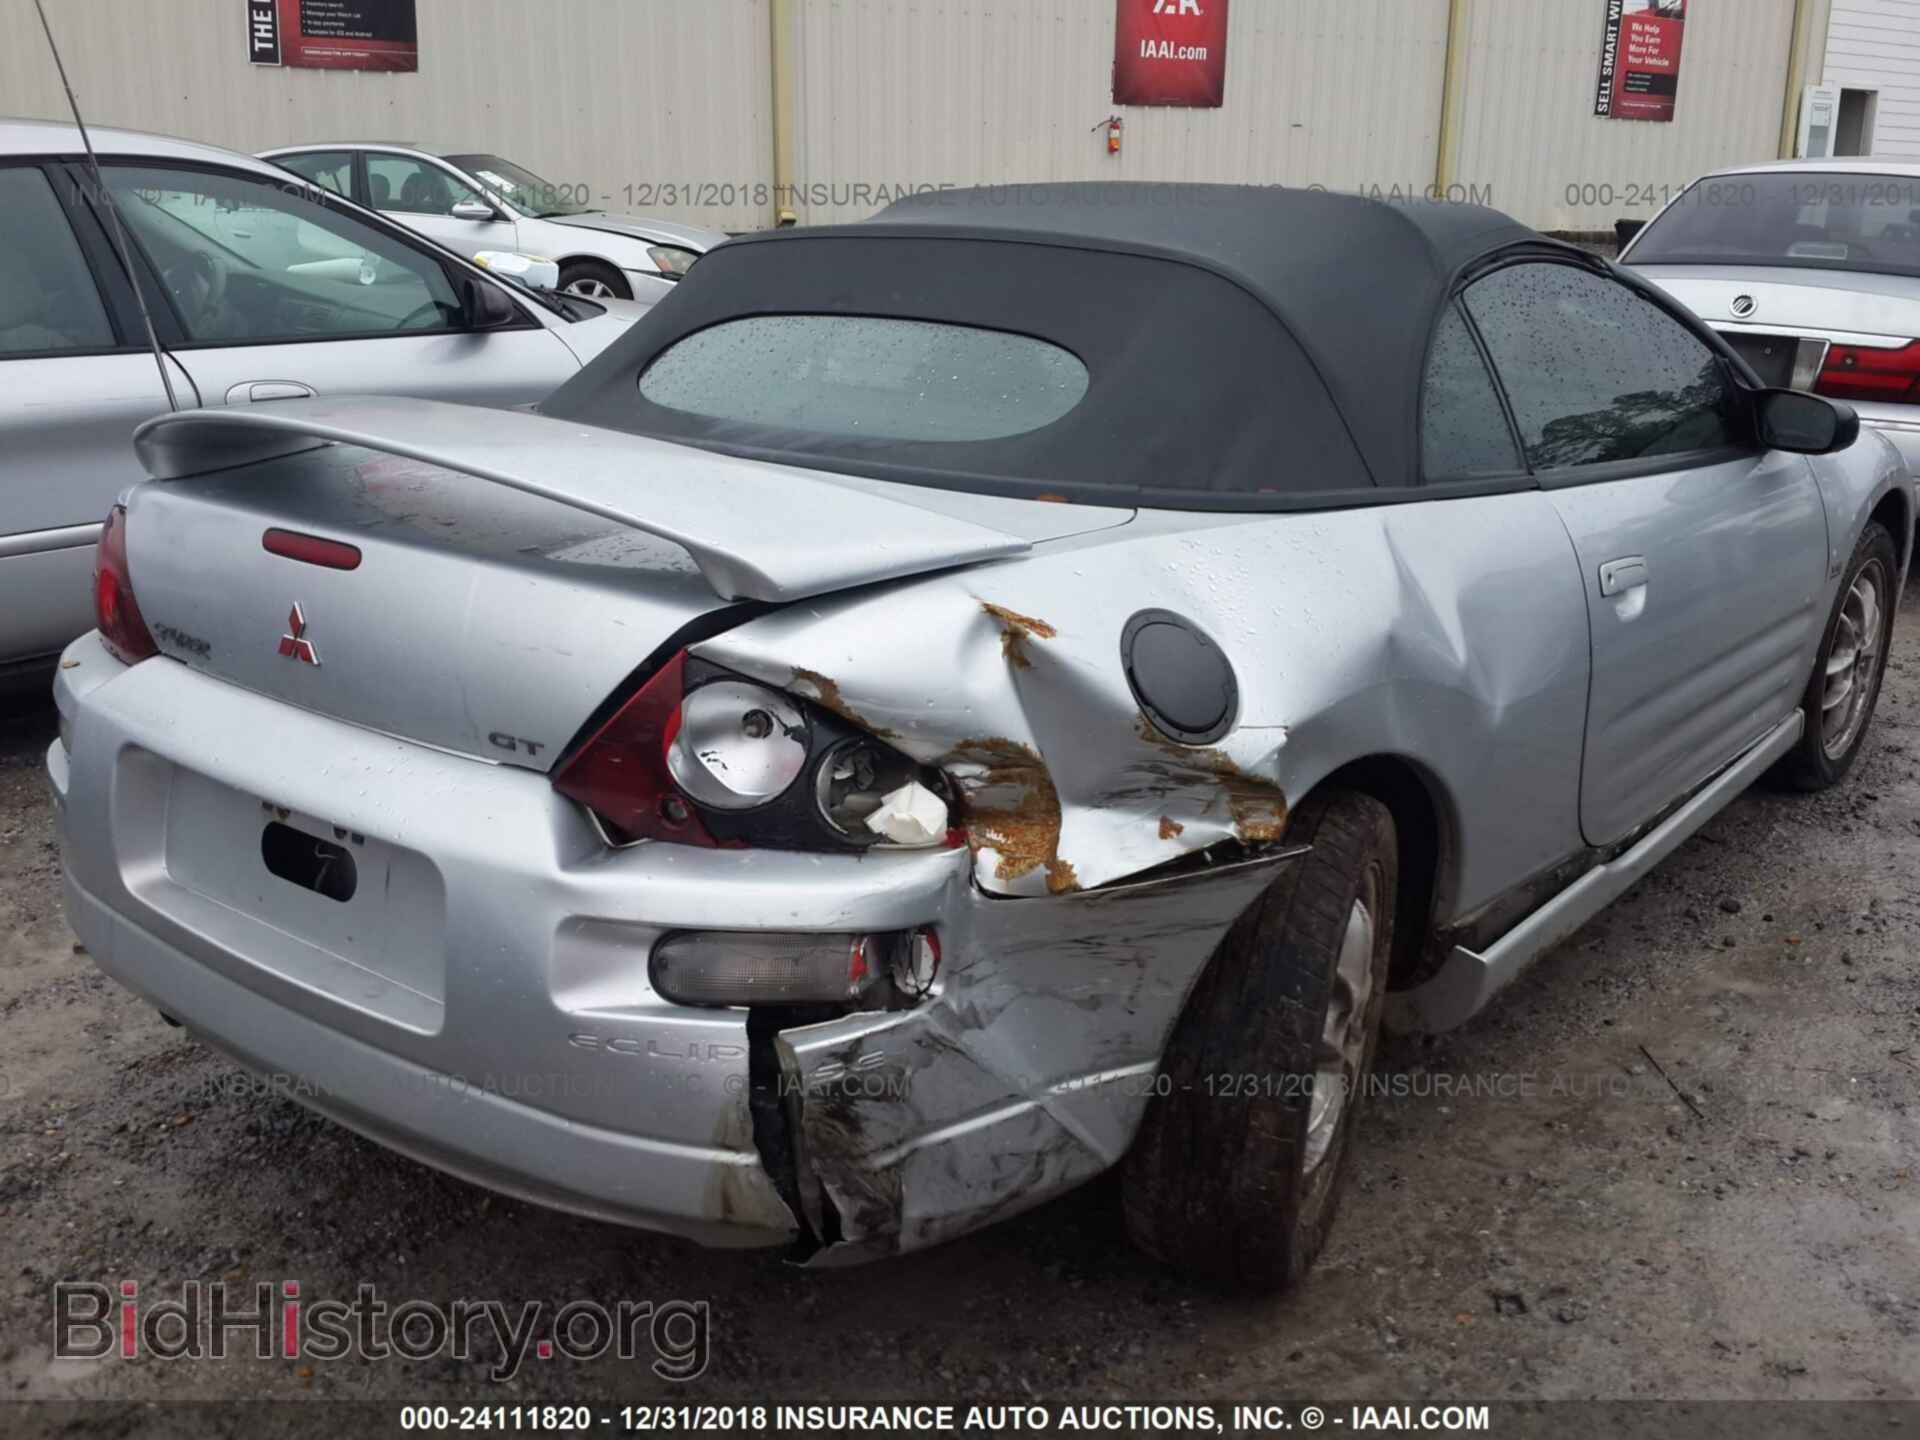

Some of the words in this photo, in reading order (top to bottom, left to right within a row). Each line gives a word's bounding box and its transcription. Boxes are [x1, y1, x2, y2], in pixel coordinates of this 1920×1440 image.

[253, 9, 274, 52] THE
[1643, 23, 1660, 34] Help
[1140, 39, 1207, 61] IAAI.com
[1602, 24, 1618, 76] SMART
[1597, 80, 1612, 113] SELL
[488, 731, 545, 757] GT
